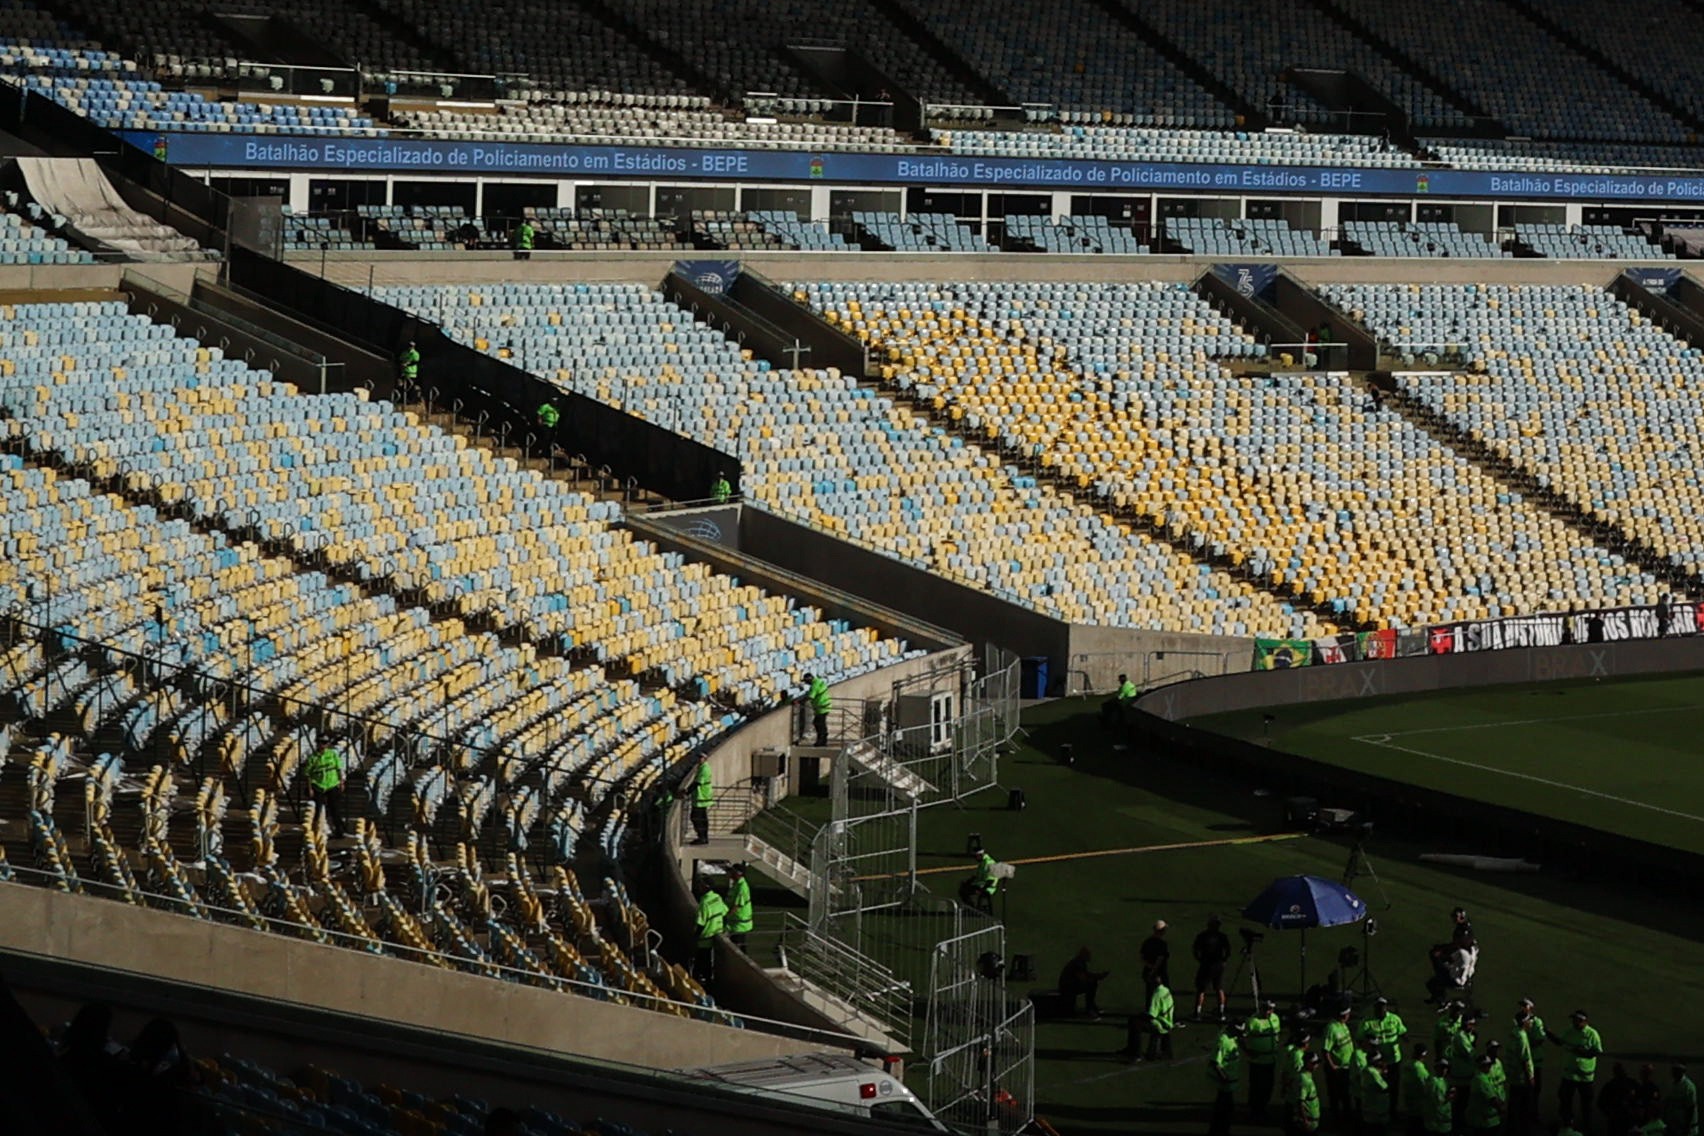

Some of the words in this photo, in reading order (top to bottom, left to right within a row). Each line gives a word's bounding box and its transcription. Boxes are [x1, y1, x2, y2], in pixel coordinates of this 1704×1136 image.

[246, 142, 319, 162] Batalhão
[324, 144, 443, 166] Especializado
[447, 148, 468, 165] de
[473, 149, 579, 169] Policiamento
[586, 155, 609, 169] em
[614, 152, 686, 171] Estádios
[702, 155, 748, 172] BEPE
[897, 161, 969, 178] Batalhão
[973, 163, 1082, 182] Especializado
[1087, 166, 1106, 181] de
[1110, 167, 1211, 185] Policiamento
[1215, 173, 1237, 185] em
[1242, 170, 1306, 186] Estádios
[1320, 172, 1362, 188] BEPE
[1490, 177, 1550, 192] Batalhão
[1554, 178, 1645, 196] Especializado
[1648, 181, 1664, 194] de
[1629, 605, 1697, 638] HONAR
